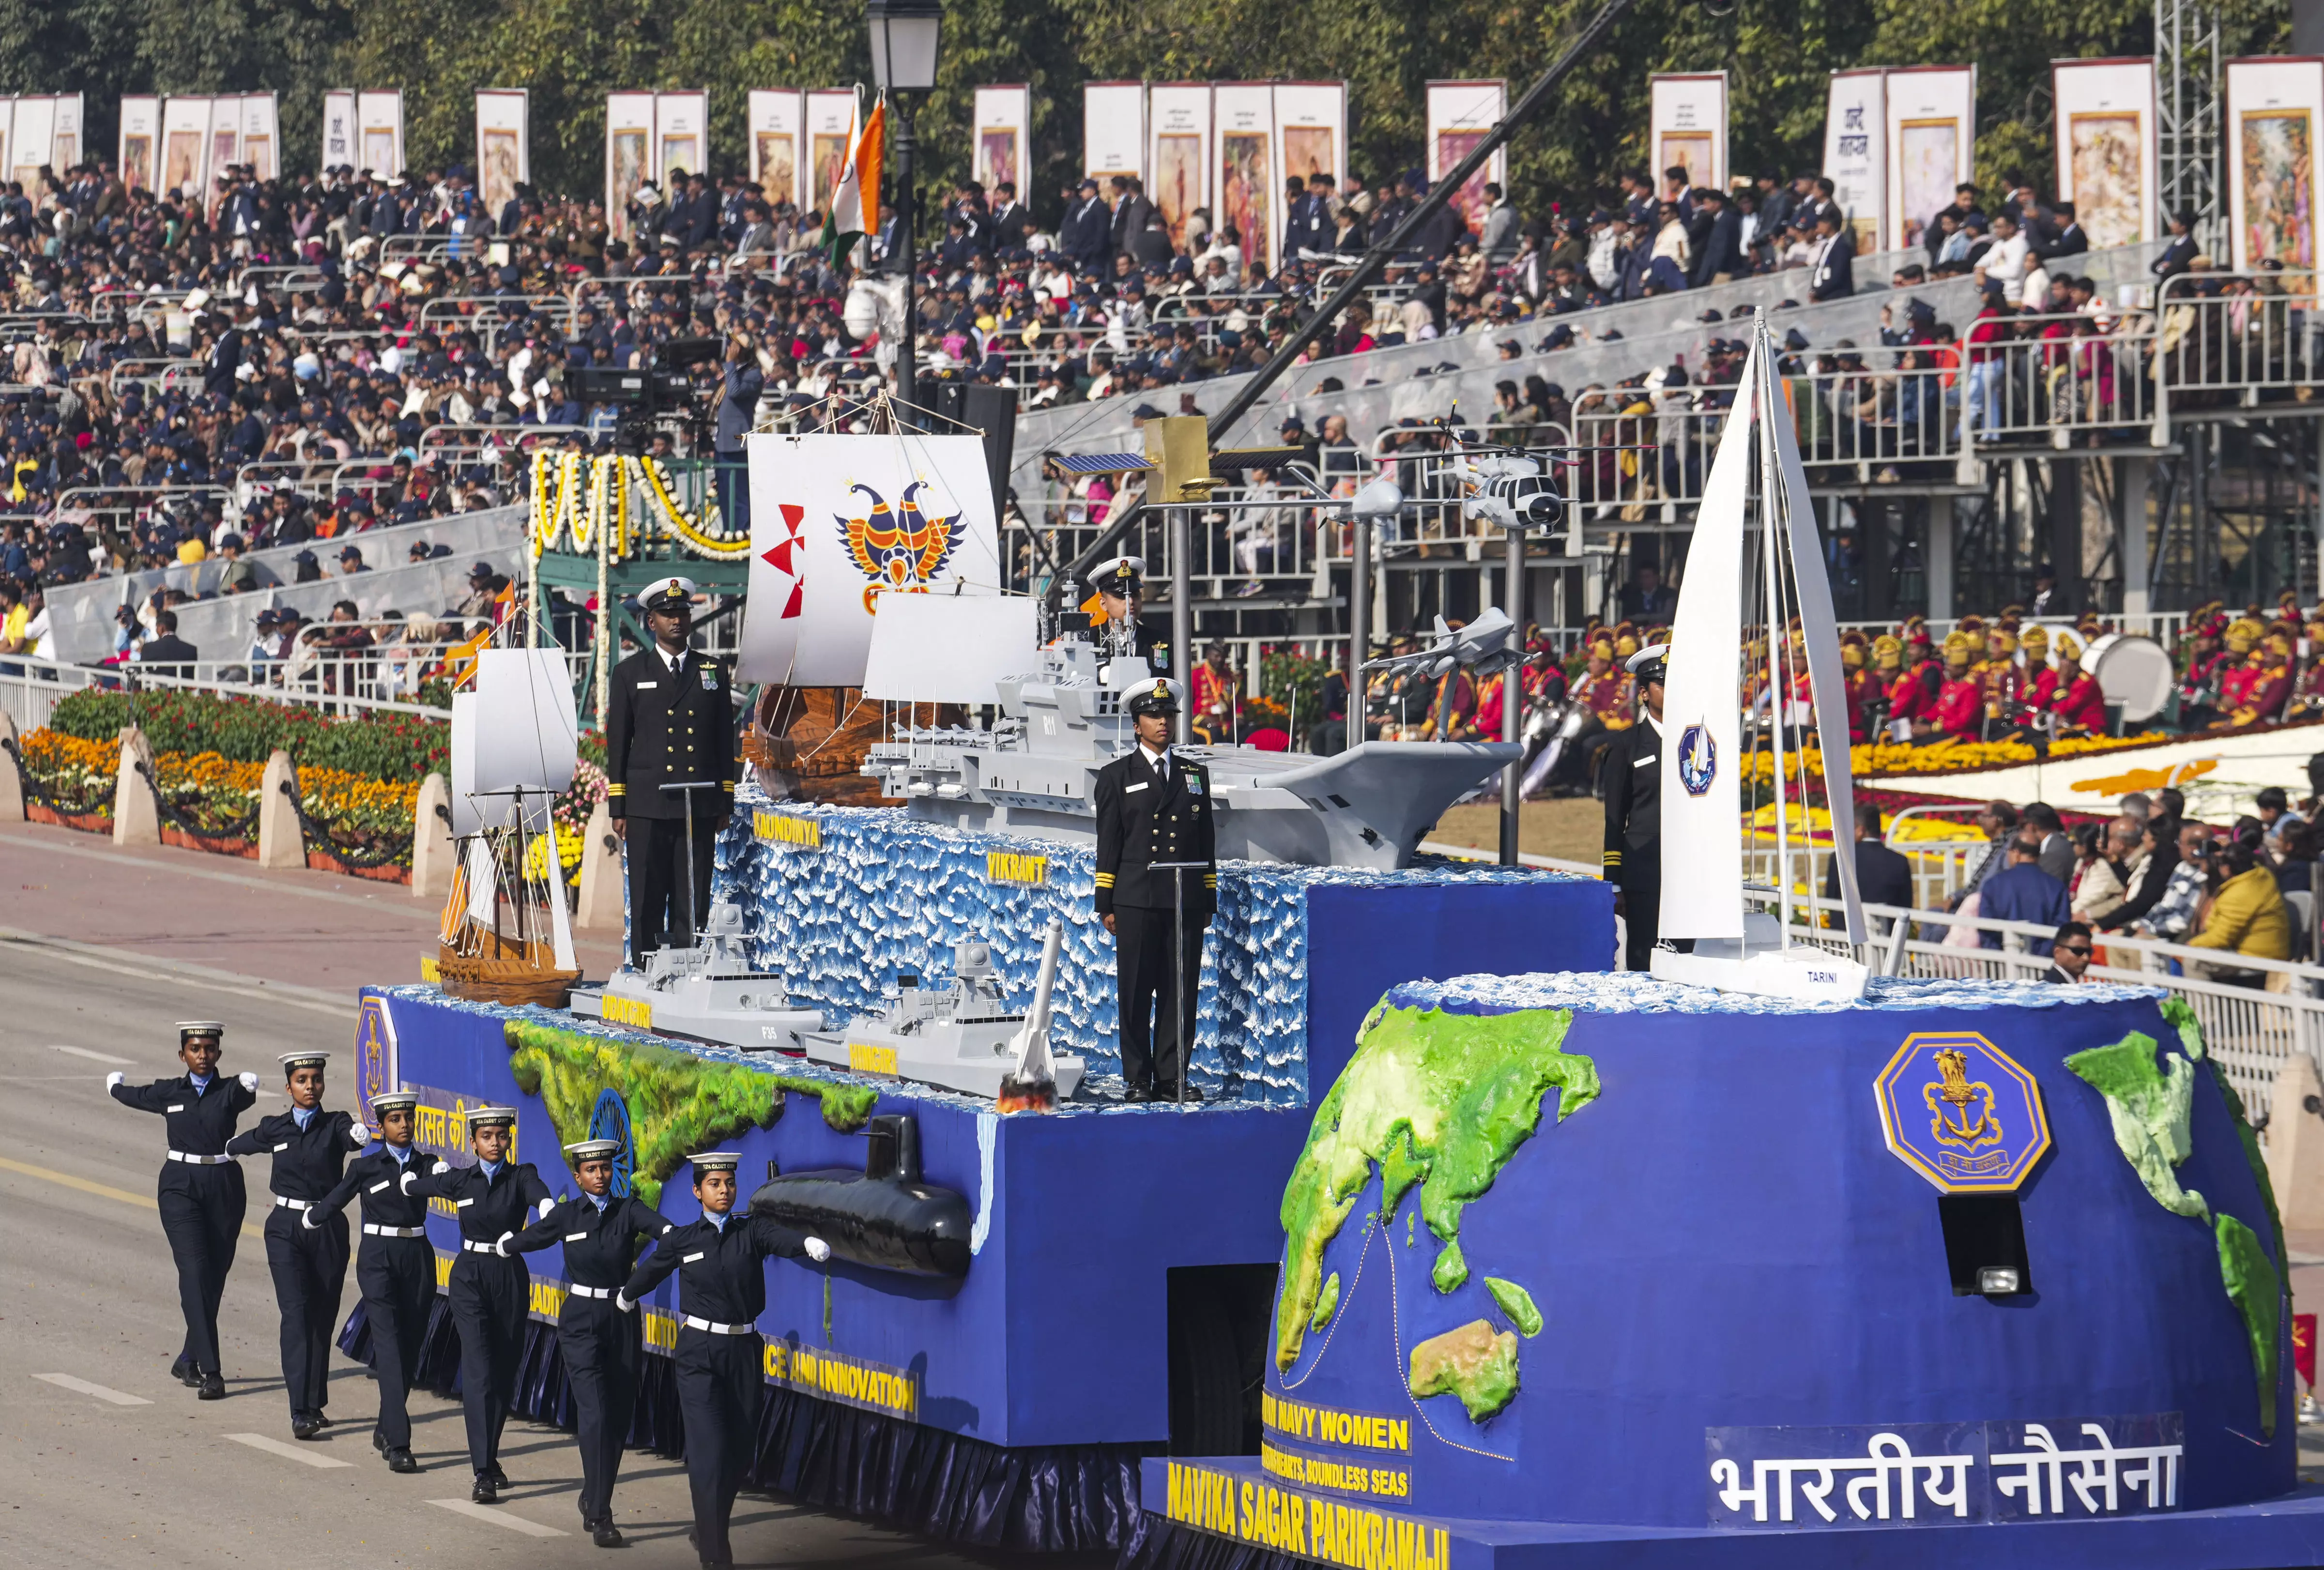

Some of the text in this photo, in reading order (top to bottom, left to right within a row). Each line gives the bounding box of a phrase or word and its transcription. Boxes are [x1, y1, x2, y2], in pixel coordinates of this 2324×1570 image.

[1042, 715, 1056, 736] R11
[753, 811, 819, 847] KAUNDINYA
[988, 852, 1046, 883] VIKRANT
[1807, 971, 1837, 984] TARINI
[602, 994, 651, 1029] UDAYGIRI
[762, 1026, 777, 1040] F35
[849, 1043, 898, 1075] HIMGIRI
[448, 1098, 466, 1153] की
[646, 1312, 678, 1350] INTO
[790, 1351, 817, 1387] AND
[819, 1359, 914, 1413] INNOVATION
[1278, 1400, 1317, 1437] NAVY
[1319, 1410, 1408, 1450] WOMEN
[1306, 1459, 1369, 1493] BOUNDLESS
[1371, 1469, 1407, 1497] SEAS
[1710, 1423, 2183, 1523] भारतीय नौसेना
[1167, 1462, 1447, 1570] NAVIKA SAGAR PARIKRAMA-II
